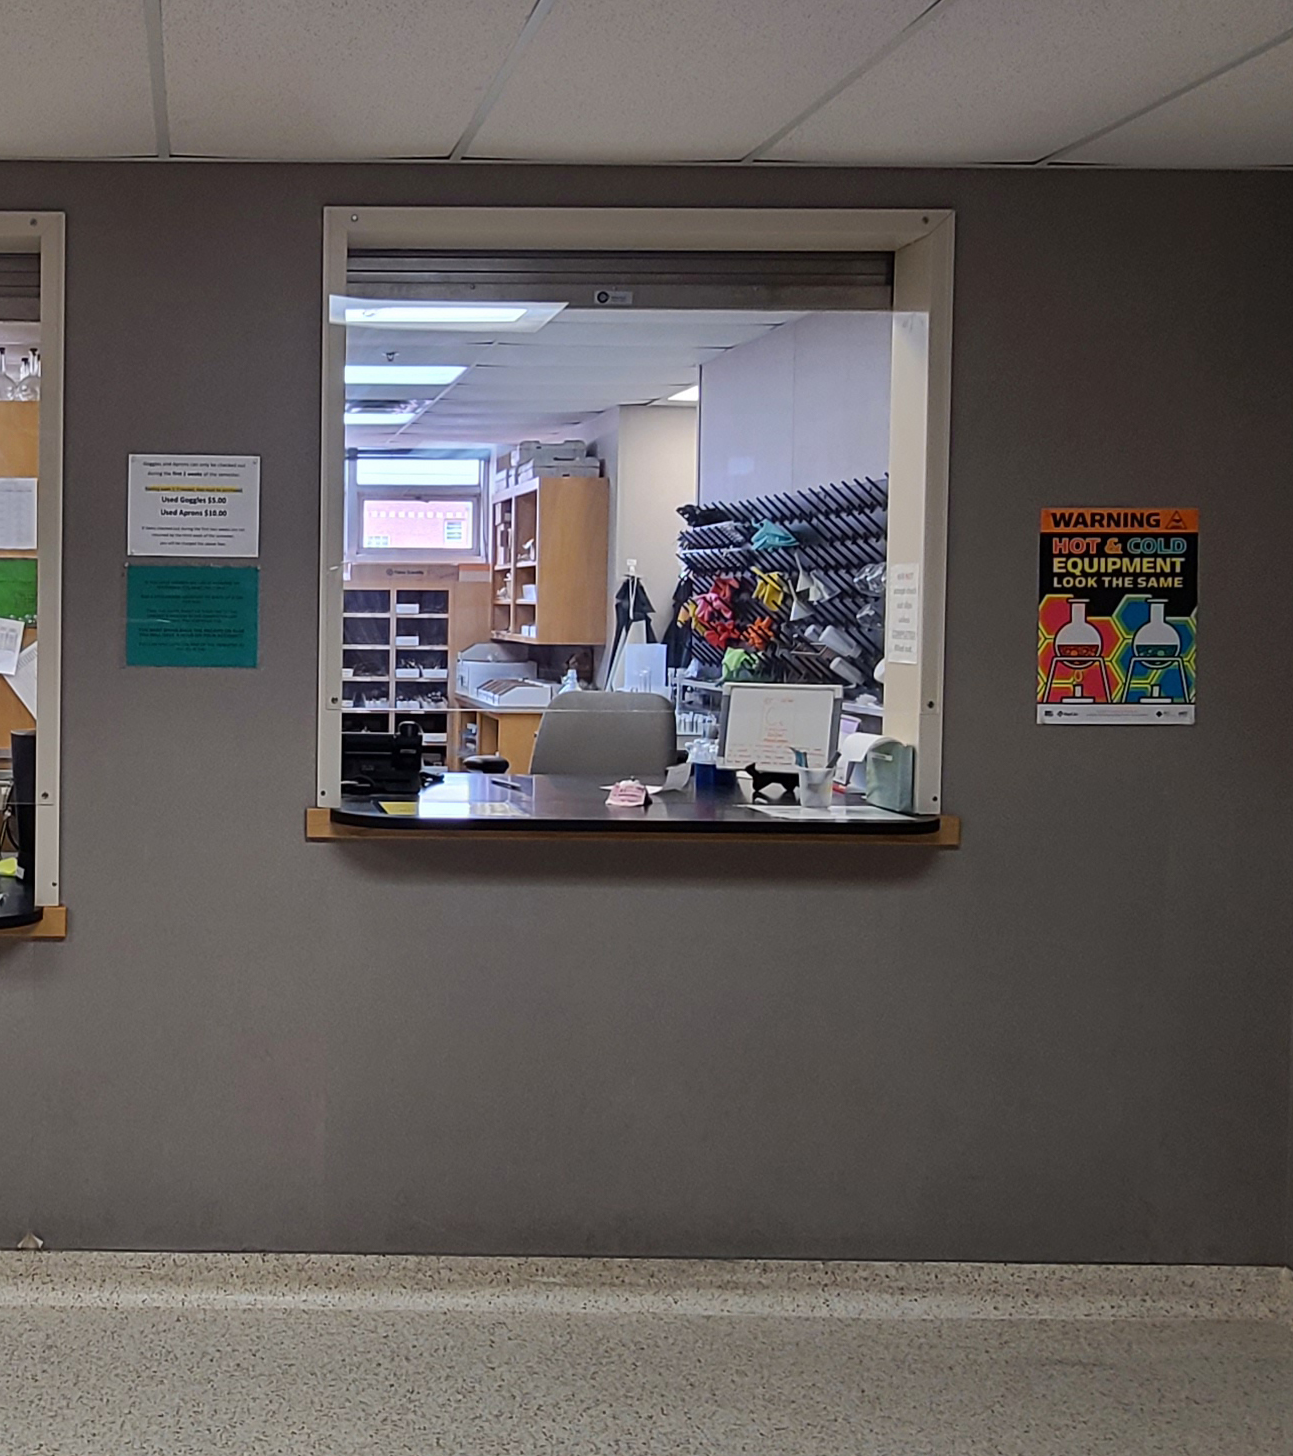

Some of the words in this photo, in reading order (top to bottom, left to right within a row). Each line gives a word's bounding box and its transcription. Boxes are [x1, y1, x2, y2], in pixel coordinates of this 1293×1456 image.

[180, 496, 206, 505] Goggles
[179, 509, 203, 517] Aprons
[1051, 512, 1161, 528] WARNING
[1052, 537, 1102, 554] HOT
[1104, 538, 1123, 554] &
[1127, 538, 1188, 554] COLD
[1052, 557, 1186, 576] EQUIPMENT
[1053, 577, 1098, 588] LOOK
[1102, 577, 1134, 588] THE
[1137, 577, 1183, 588] SAME
